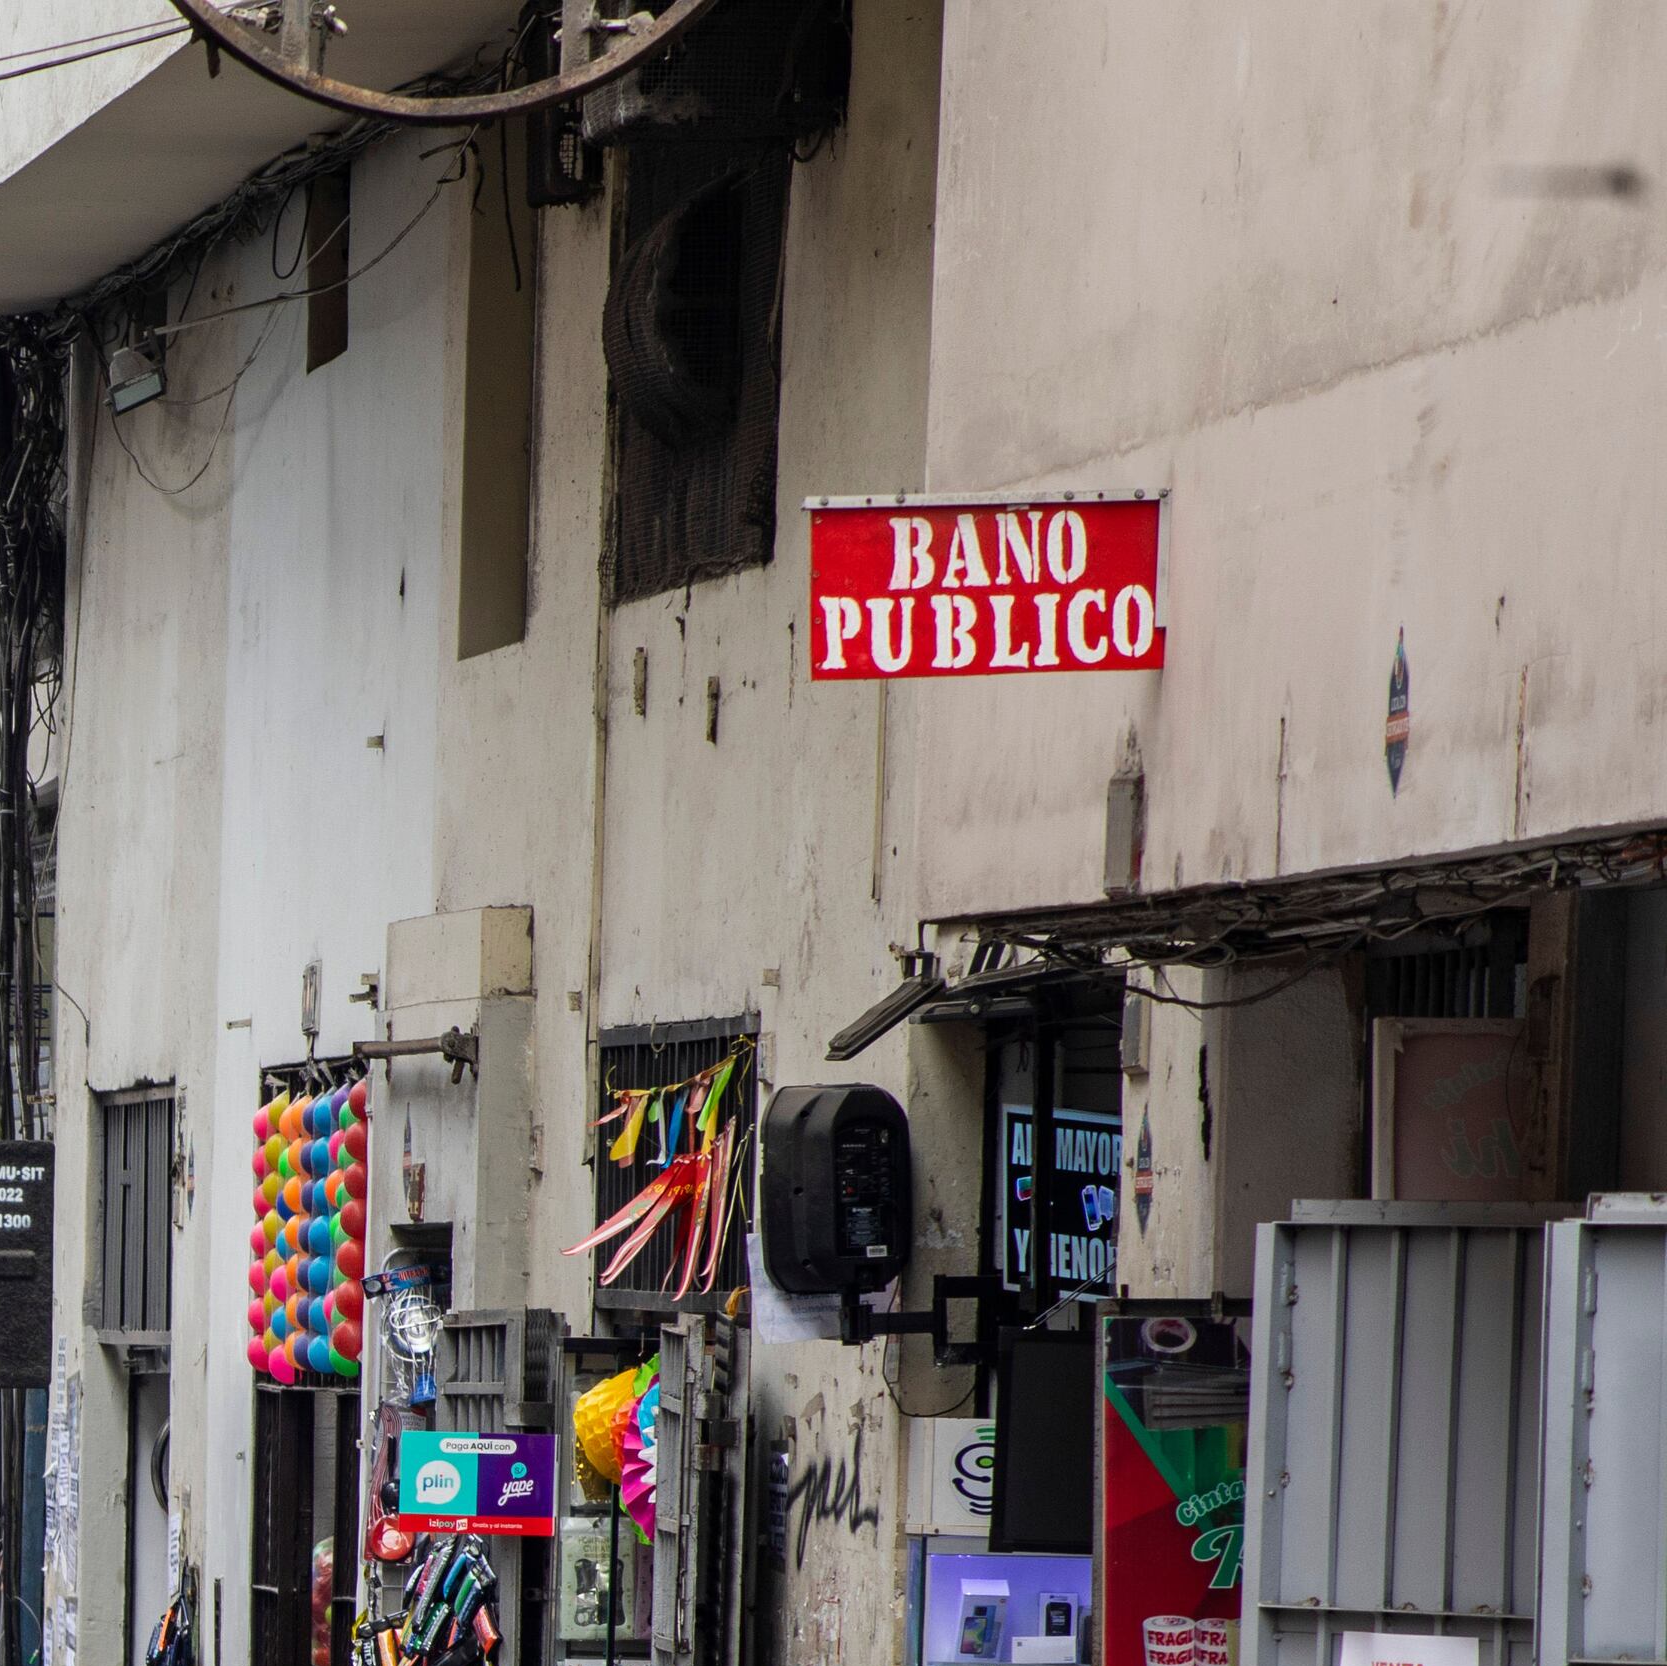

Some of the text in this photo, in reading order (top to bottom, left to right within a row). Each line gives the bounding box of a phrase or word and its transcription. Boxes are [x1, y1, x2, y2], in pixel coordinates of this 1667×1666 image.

[888, 510, 1088, 591] BANO
[820, 584, 1154, 673] PUBLICO
[1014, 1228, 1030, 1273] Y
[445, 1442, 469, 1451] Paga
[470, 1441, 493, 1451] AQUÍ
[422, 1474, 455, 1491] plin
[497, 1479, 534, 1506] yape
[428, 1518, 455, 1529] izipay
